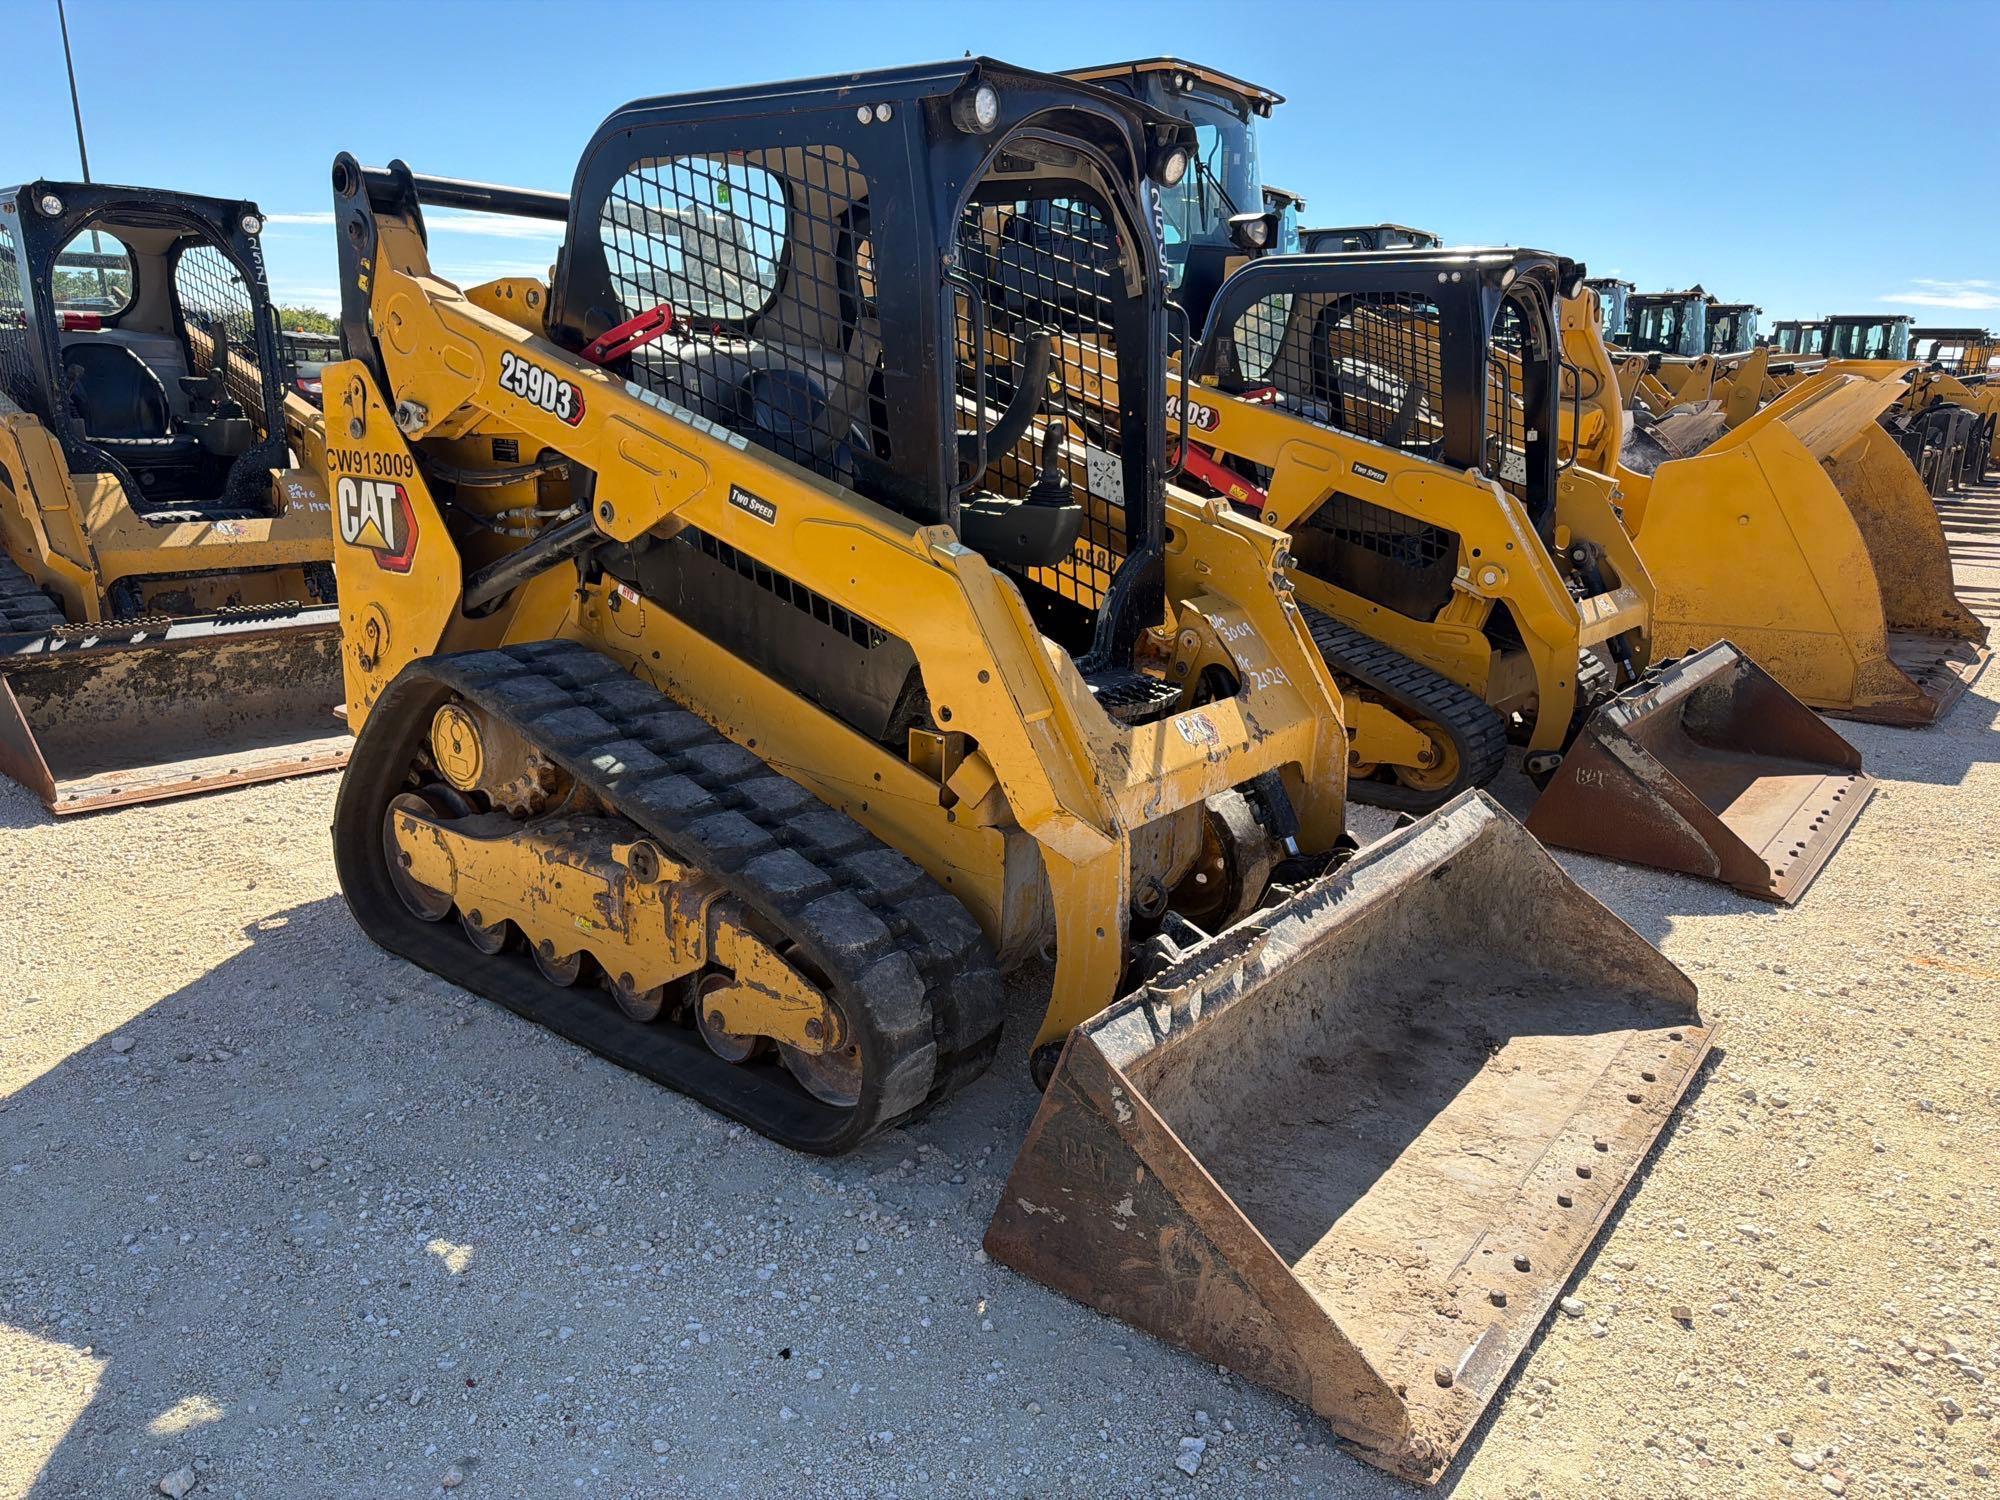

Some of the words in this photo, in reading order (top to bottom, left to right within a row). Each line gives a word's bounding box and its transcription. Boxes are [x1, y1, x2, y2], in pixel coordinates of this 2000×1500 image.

[500, 352, 572, 419] 259D3
[326, 448, 414, 478] CW913009
[338, 477, 396, 550] CAT
[1221, 622, 1256, 642] 3009
